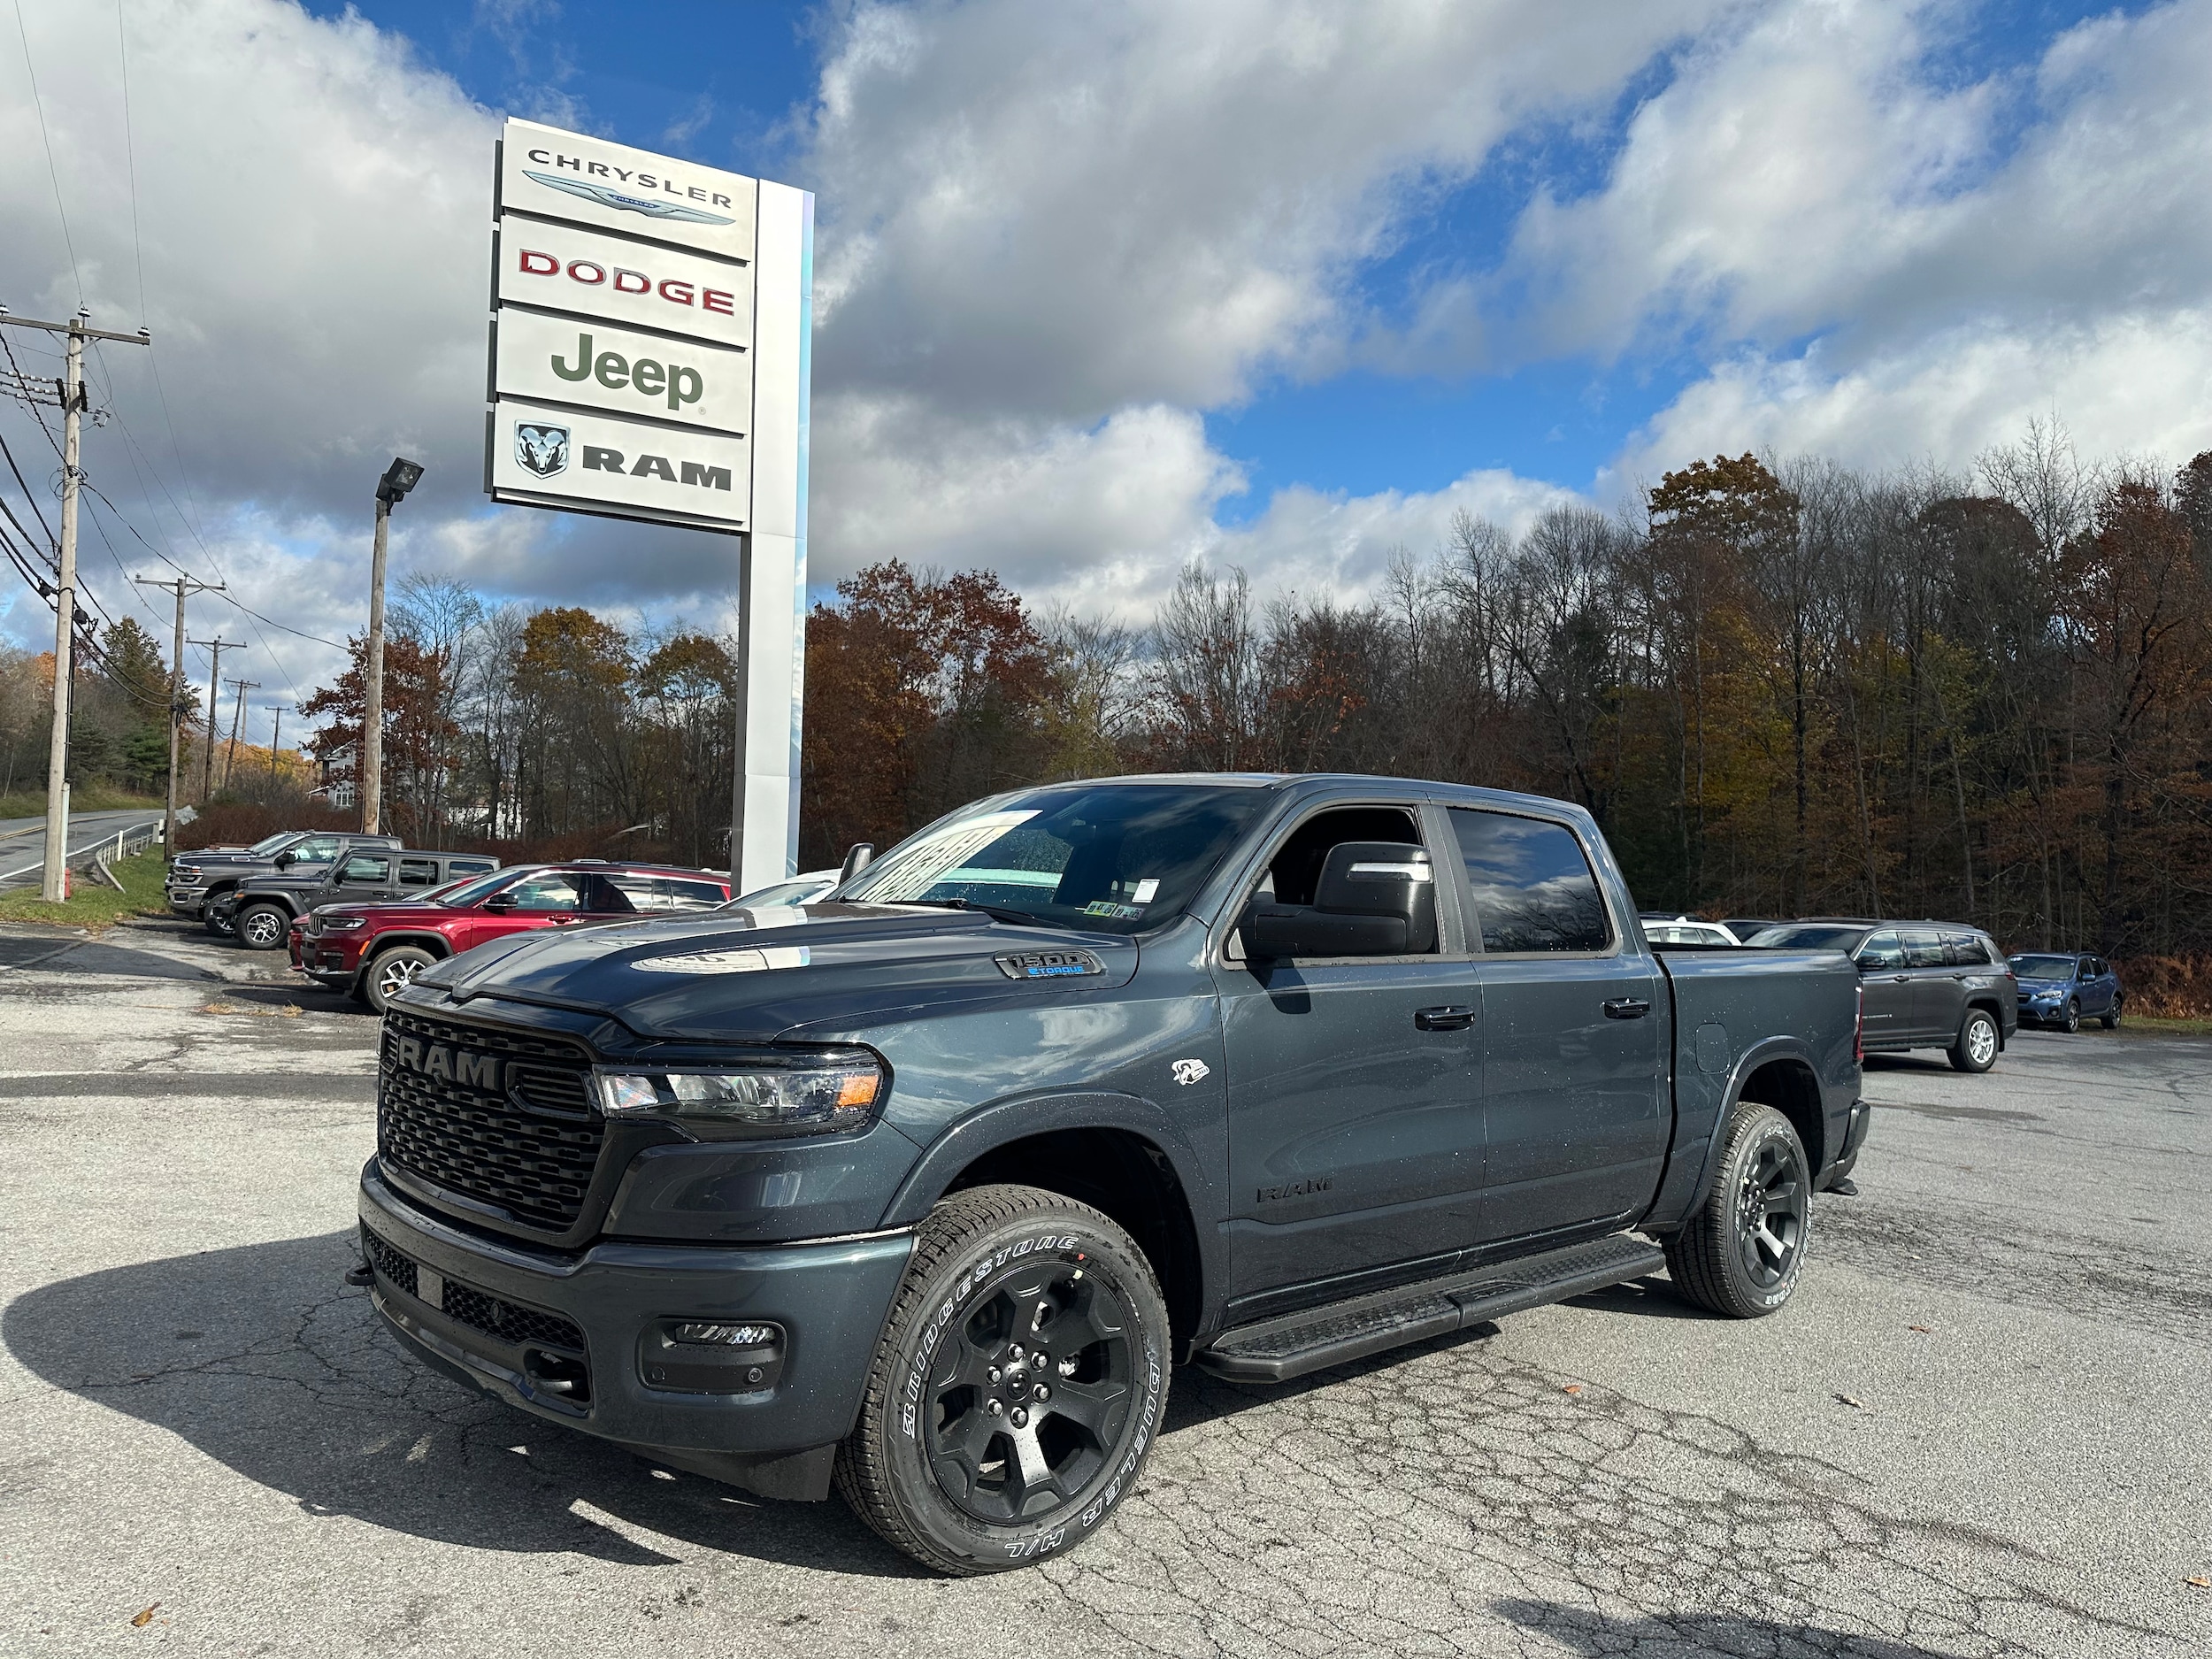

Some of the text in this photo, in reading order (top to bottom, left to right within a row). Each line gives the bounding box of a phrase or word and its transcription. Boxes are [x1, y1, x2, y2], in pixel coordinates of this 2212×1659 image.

[528, 149, 733, 209] CHRYSLER
[518, 248, 735, 317] DODGE
[550, 333, 704, 411] Jeep
[582, 445, 732, 492] RAM
[1009, 953, 1083, 969] 1500
[399, 1036, 503, 1091] RAM
[1256, 1178, 1333, 1203] RAM
[902, 1235, 1079, 1440] BRIDGESTONE
[1003, 1362, 1161, 1558] DUELER H/L
